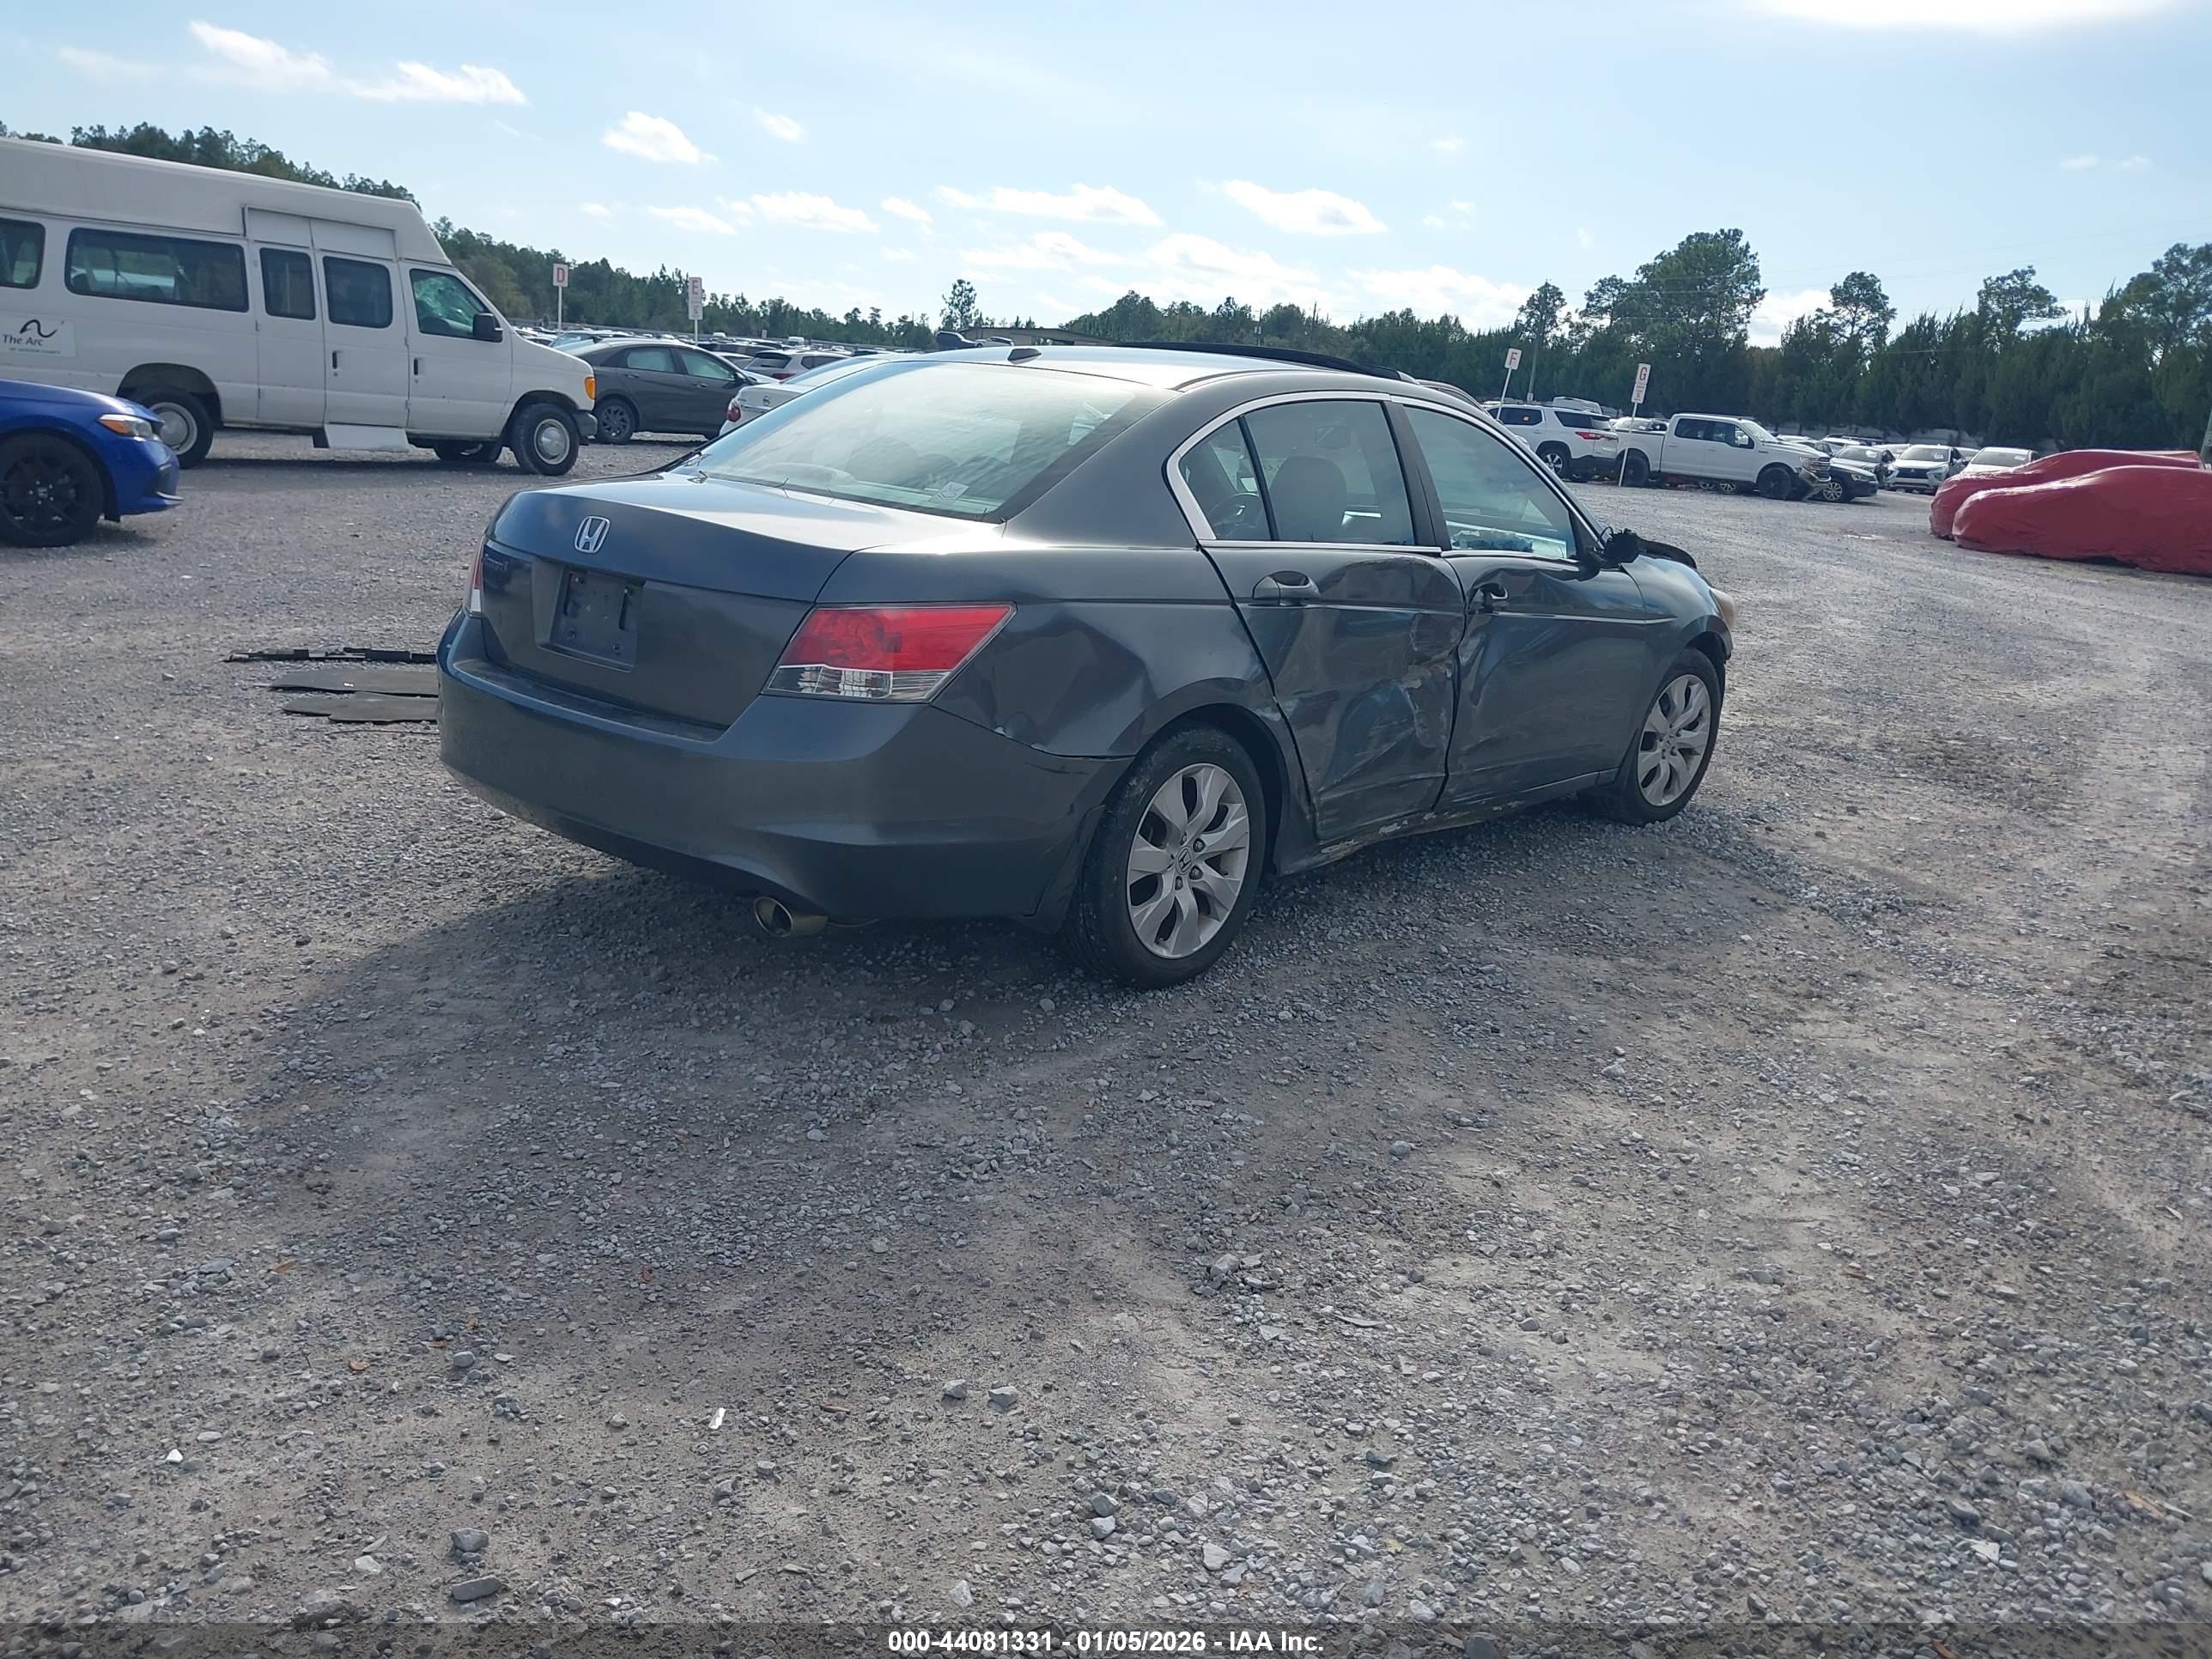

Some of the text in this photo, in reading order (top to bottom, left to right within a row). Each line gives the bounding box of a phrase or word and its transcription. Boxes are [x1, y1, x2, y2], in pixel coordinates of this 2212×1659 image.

[557, 267, 565, 283] D
[692, 279, 698, 295] E
[3, 334, 44, 346] The Arc
[1509, 352, 1518, 365] F
[1639, 367, 1648, 380] G
